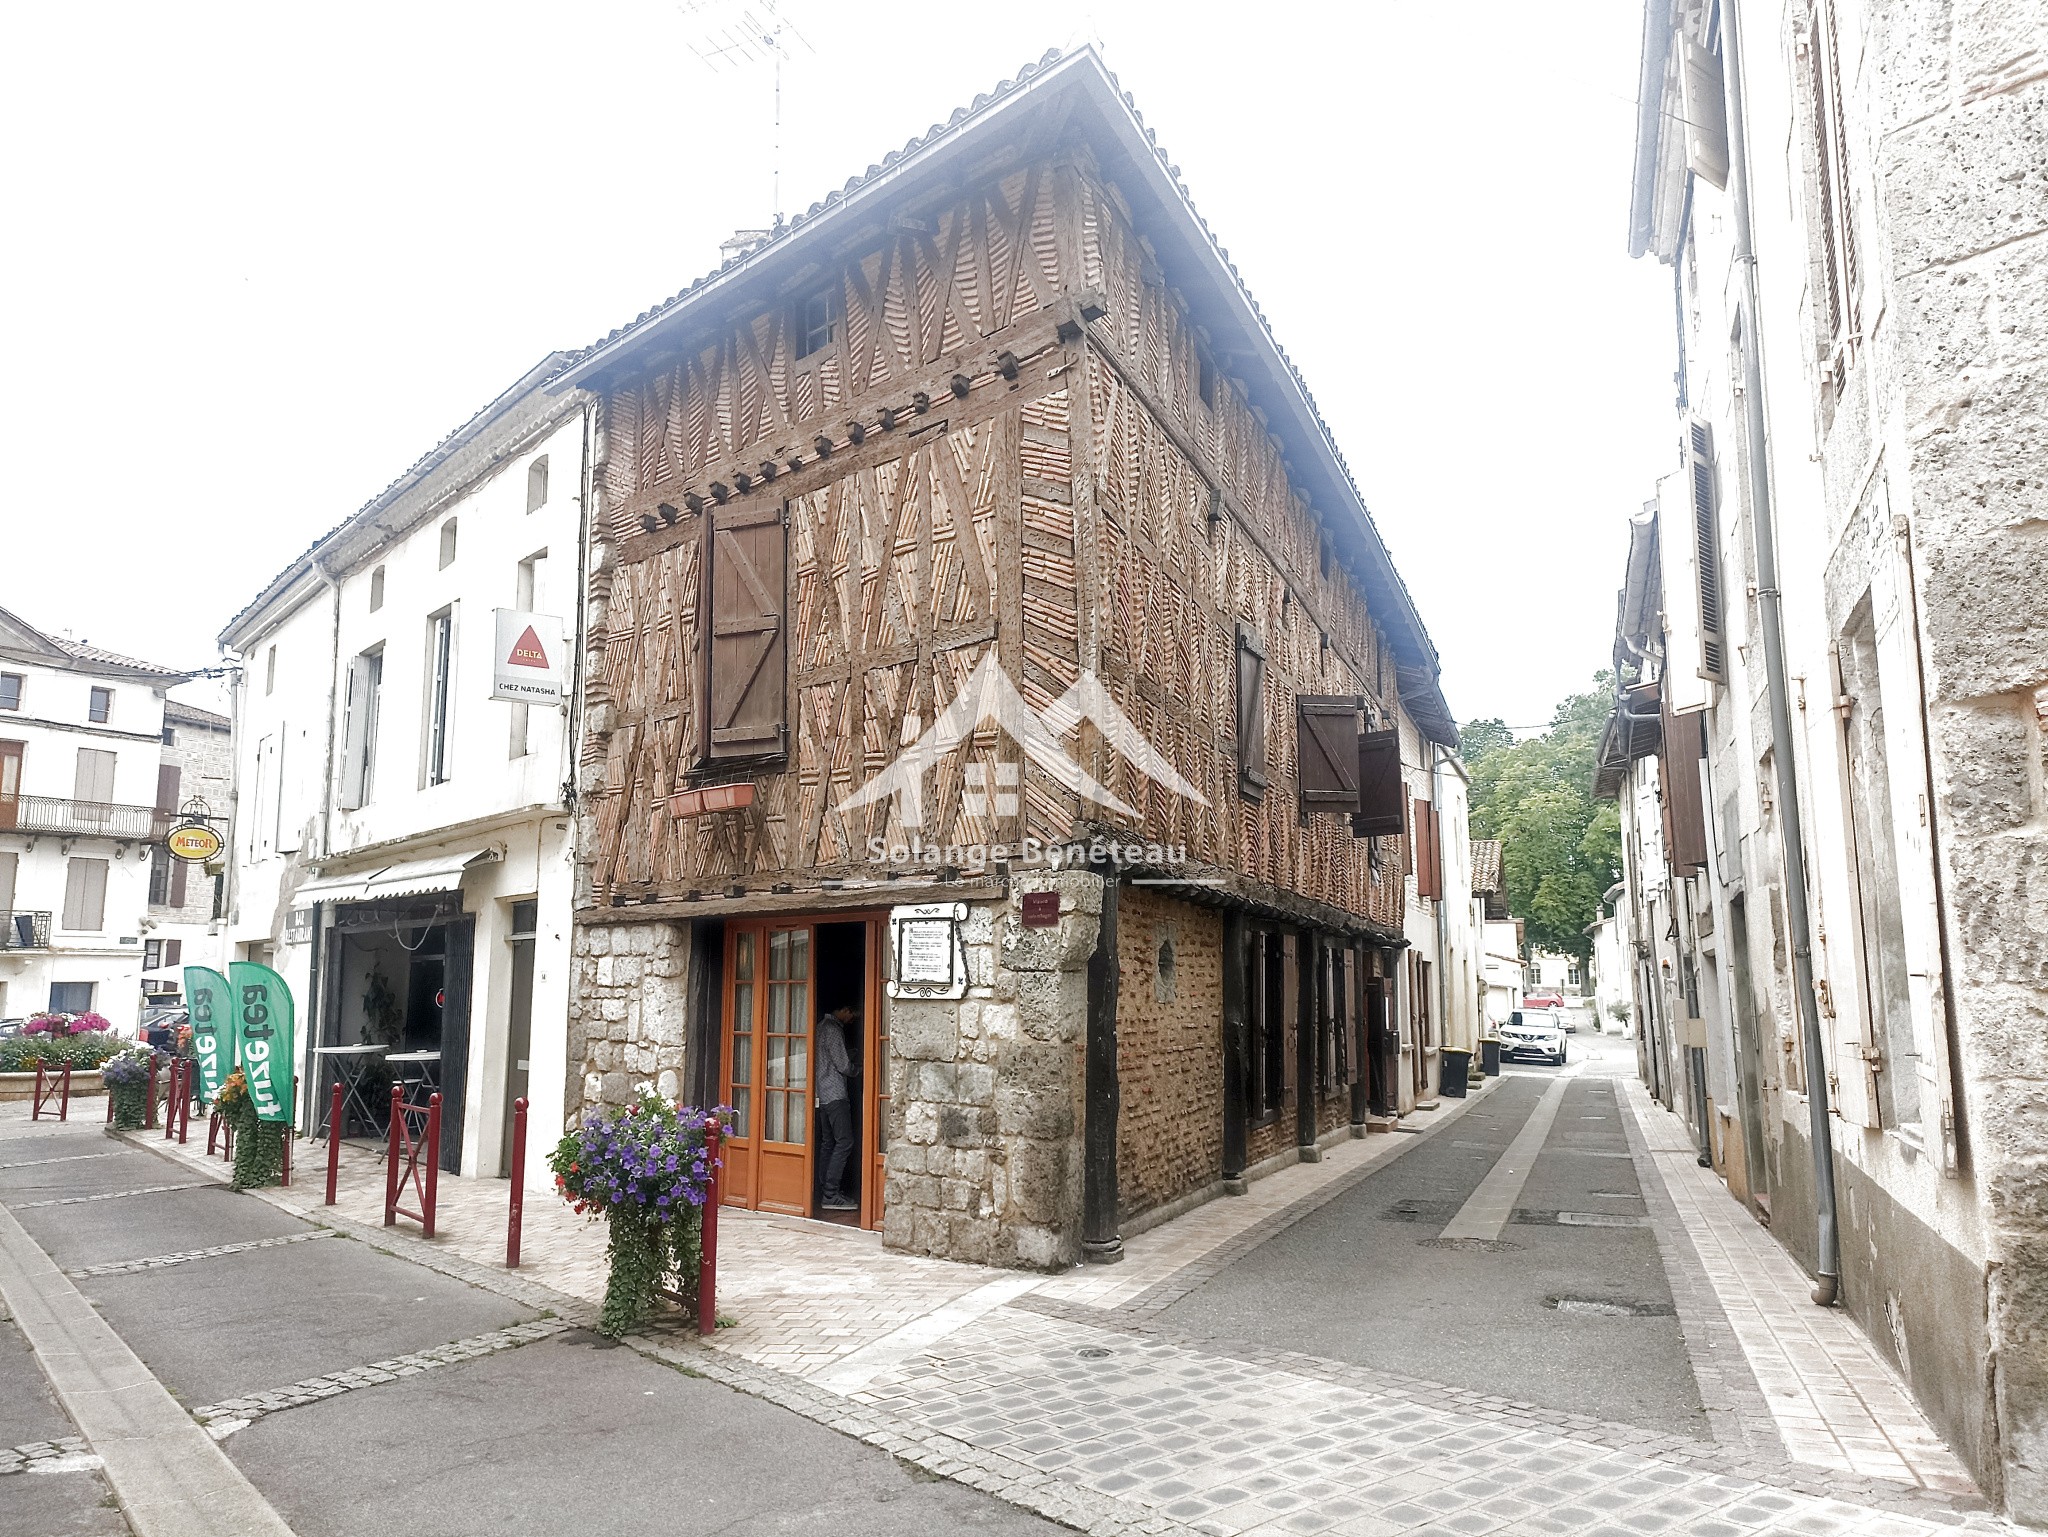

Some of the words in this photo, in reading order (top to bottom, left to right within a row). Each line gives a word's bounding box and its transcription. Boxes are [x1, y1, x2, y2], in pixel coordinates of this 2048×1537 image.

[516, 648, 543, 660] DELTA
[499, 682, 519, 692] CHEZ
[520, 685, 556, 696] NATASHA
